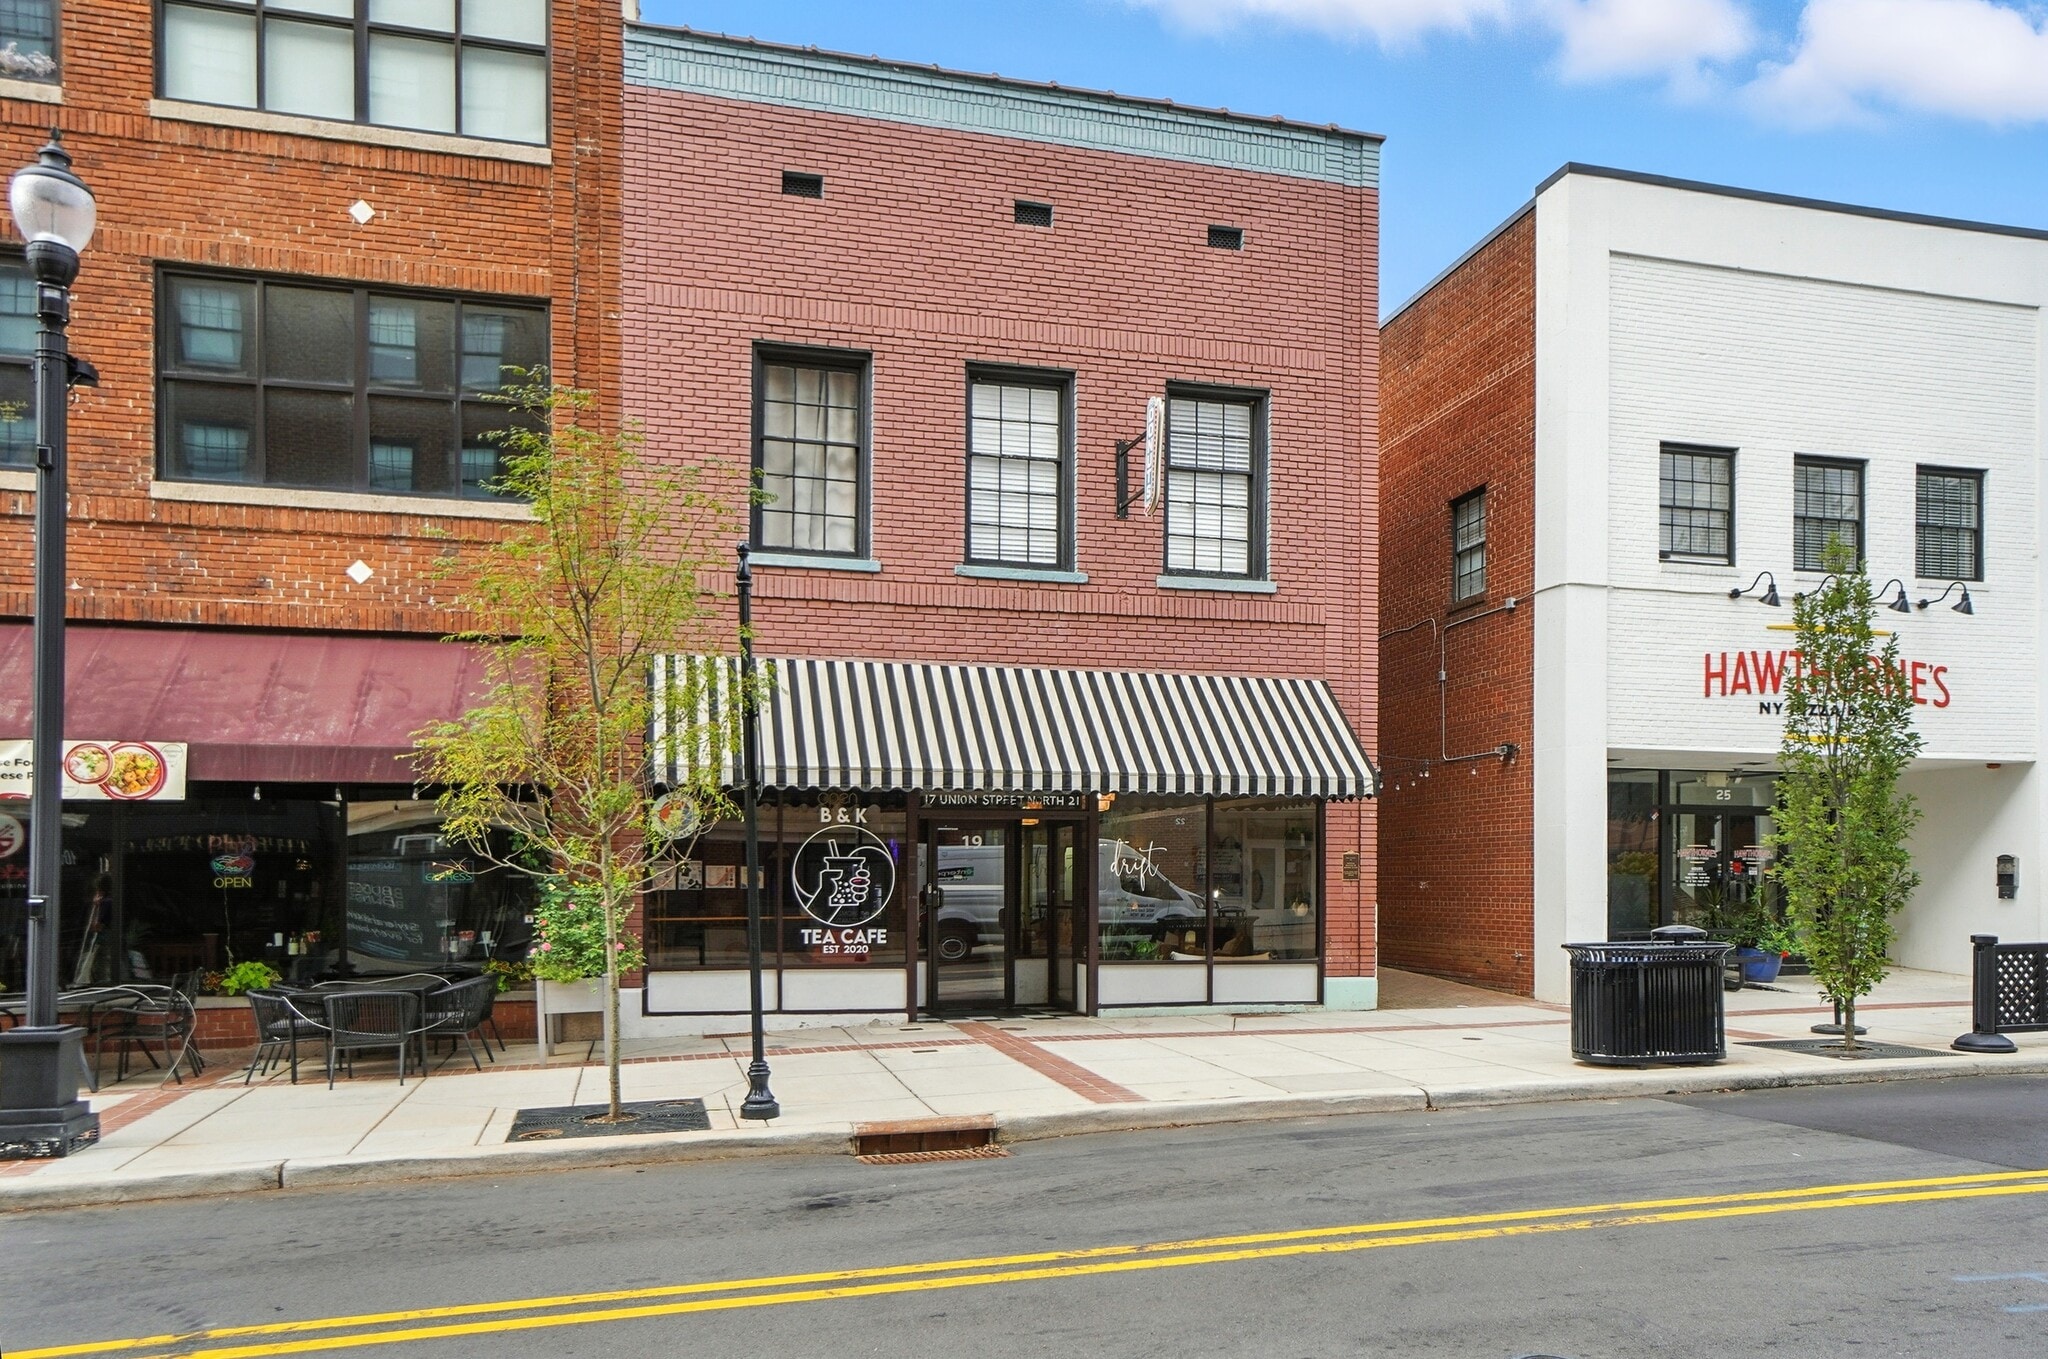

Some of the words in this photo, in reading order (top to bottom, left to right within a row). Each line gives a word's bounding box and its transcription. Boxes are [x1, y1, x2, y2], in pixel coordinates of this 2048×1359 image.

[1759, 702, 1783, 715] NY
[14, 758, 33, 767] Fo
[925, 795, 937, 804] 17
[940, 795, 977, 804] UNION
[1027, 795, 1064, 806] NORTH
[1068, 796, 1080, 806] 21
[1716, 789, 1731, 800] 25
[820, 807, 832, 823] B
[837, 807, 850, 823] &
[855, 808, 867, 823] K
[961, 835, 982, 849] 19
[1110, 838, 1168, 891] drift
[213, 877, 252, 888] OPEN
[801, 929, 836, 944] TEA
[840, 929, 887, 944] CAFE
[823, 945, 839, 953] EST
[843, 945, 869, 953] 2020
